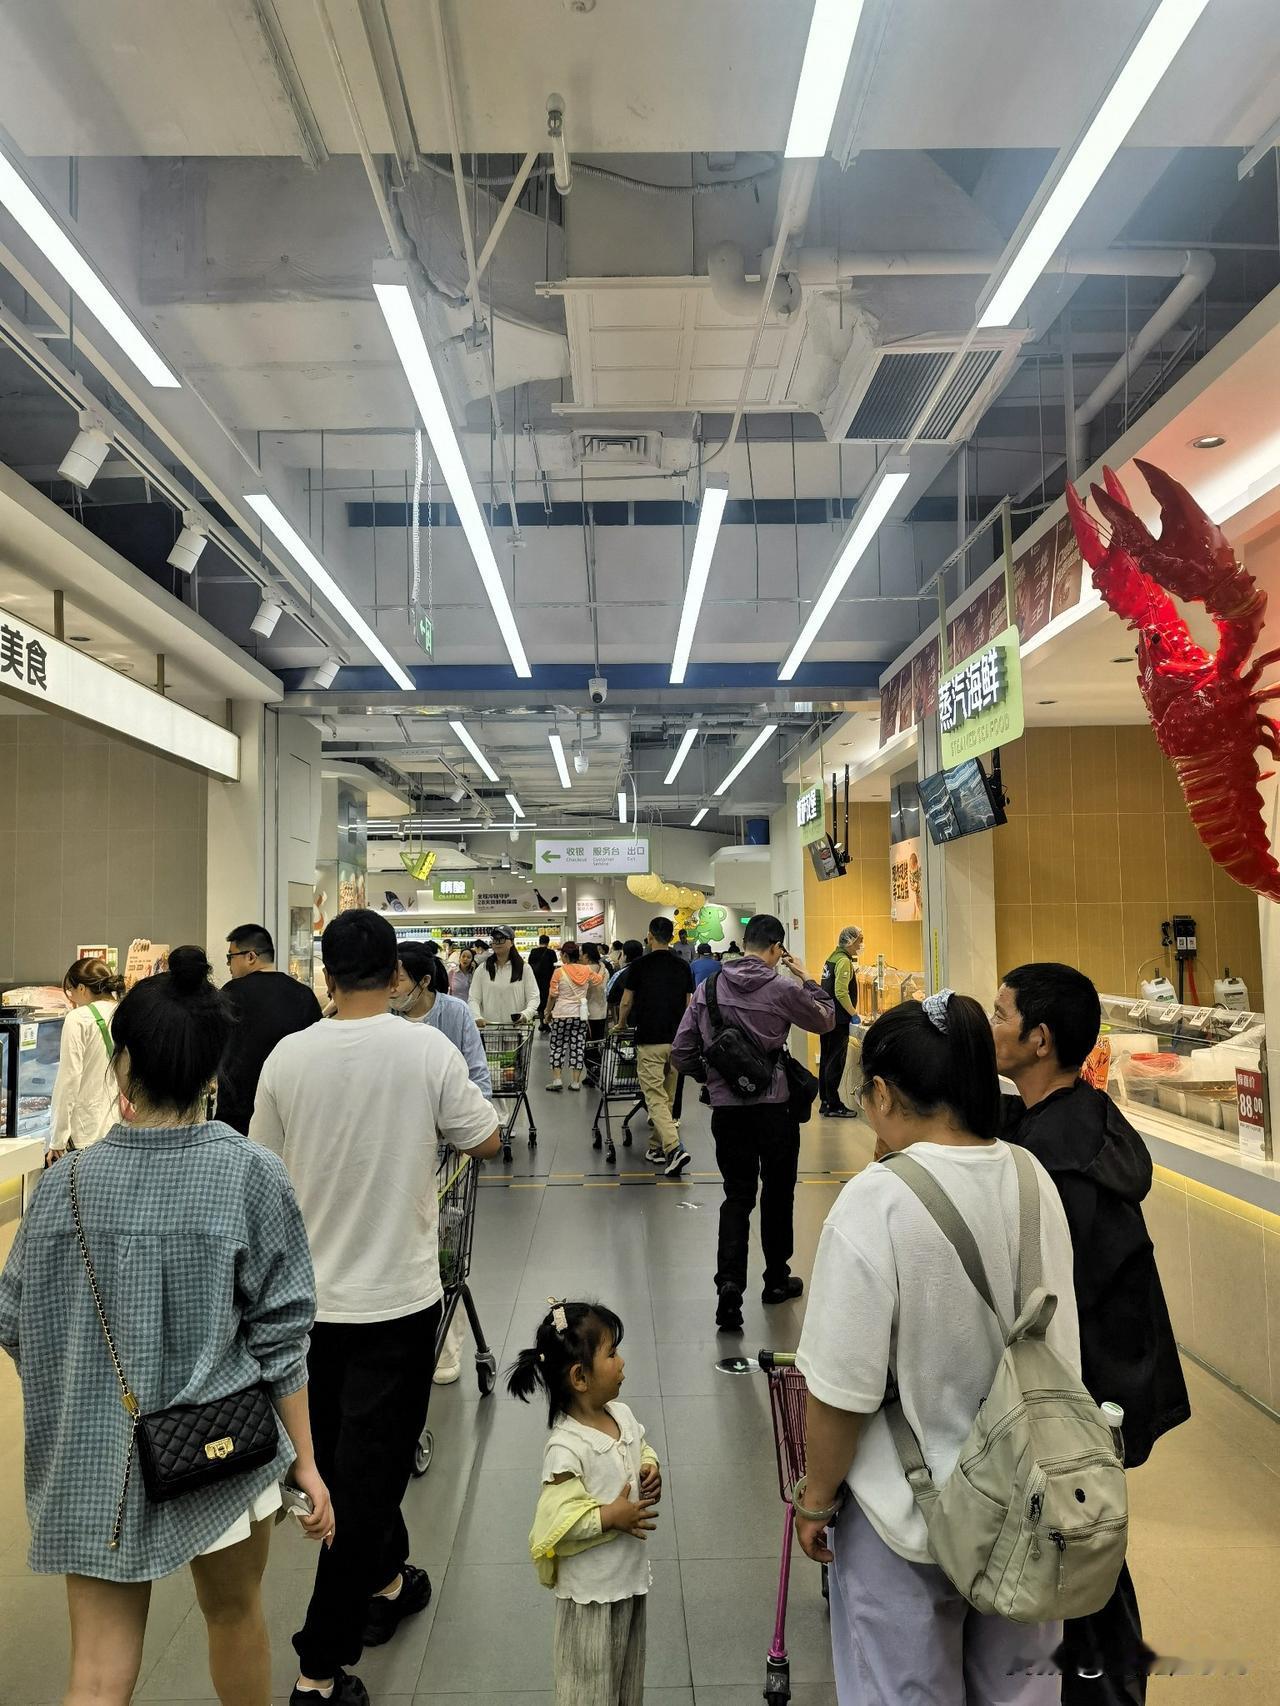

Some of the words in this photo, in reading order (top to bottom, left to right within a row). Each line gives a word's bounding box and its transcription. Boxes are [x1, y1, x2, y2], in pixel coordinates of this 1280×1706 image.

[0, 623, 47, 692] 美食
[938, 646, 1000, 734] 蒸汽海鲜
[566, 847, 584, 856] 收银
[593, 846, 620, 856] 服务台
[627, 846, 645, 856] 出口
